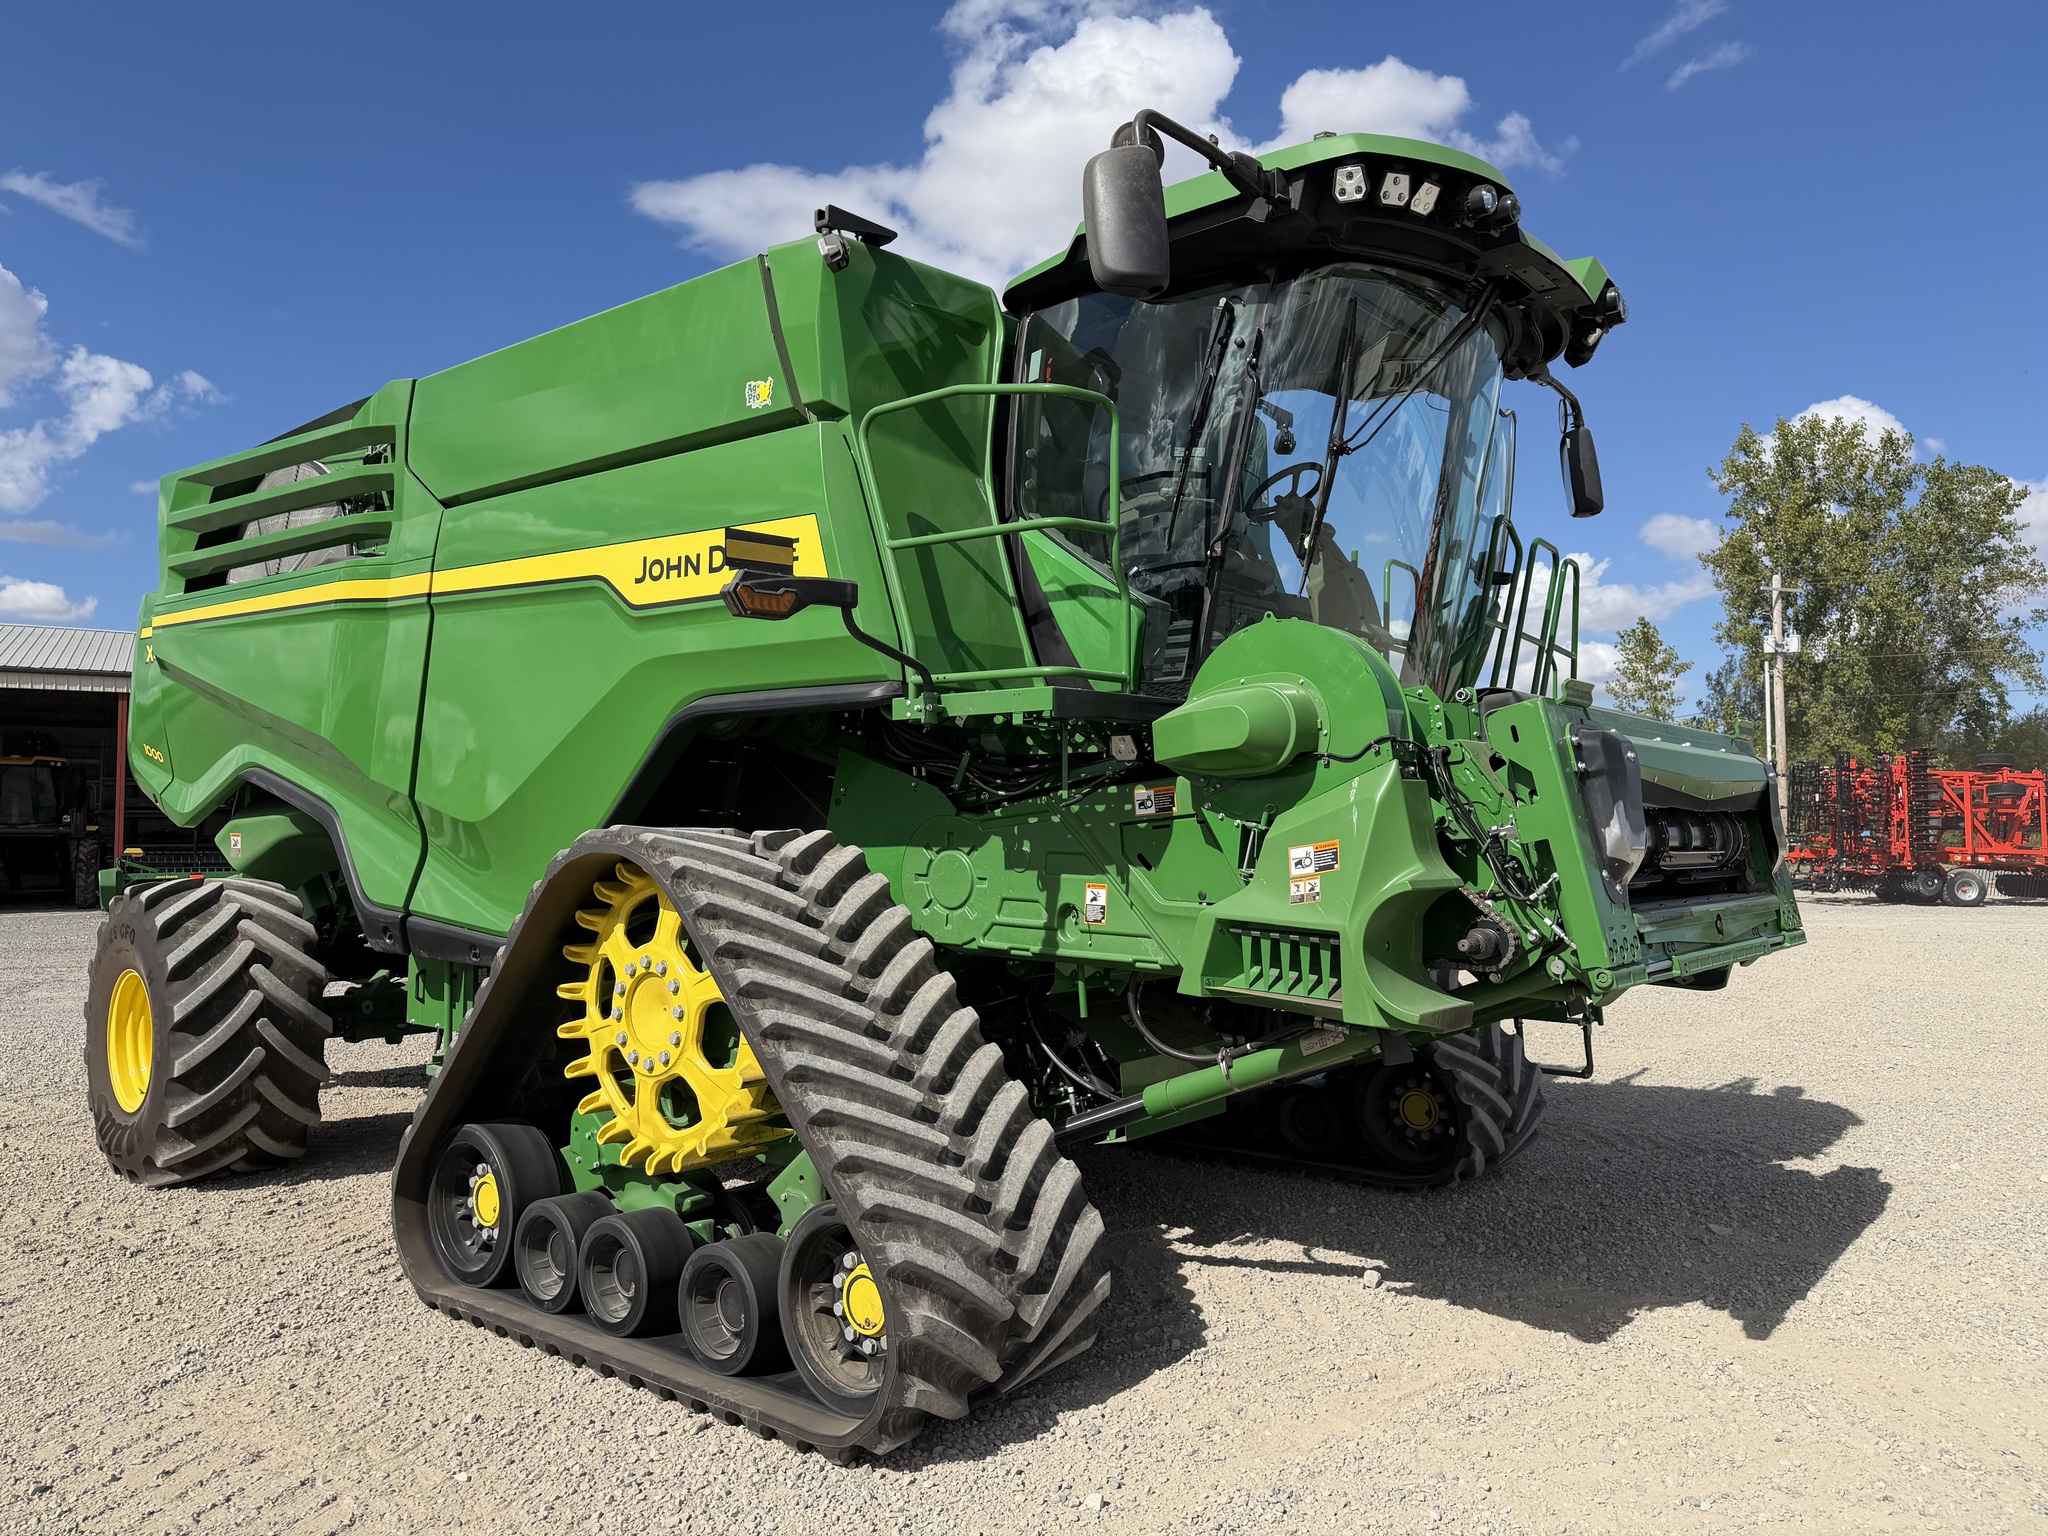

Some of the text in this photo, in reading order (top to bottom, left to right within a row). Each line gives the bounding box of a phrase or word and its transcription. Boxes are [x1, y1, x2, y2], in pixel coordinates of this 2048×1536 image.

[634, 553, 701, 584] JOHN
[145, 644, 157, 664] X
[143, 742, 164, 763] 1000
